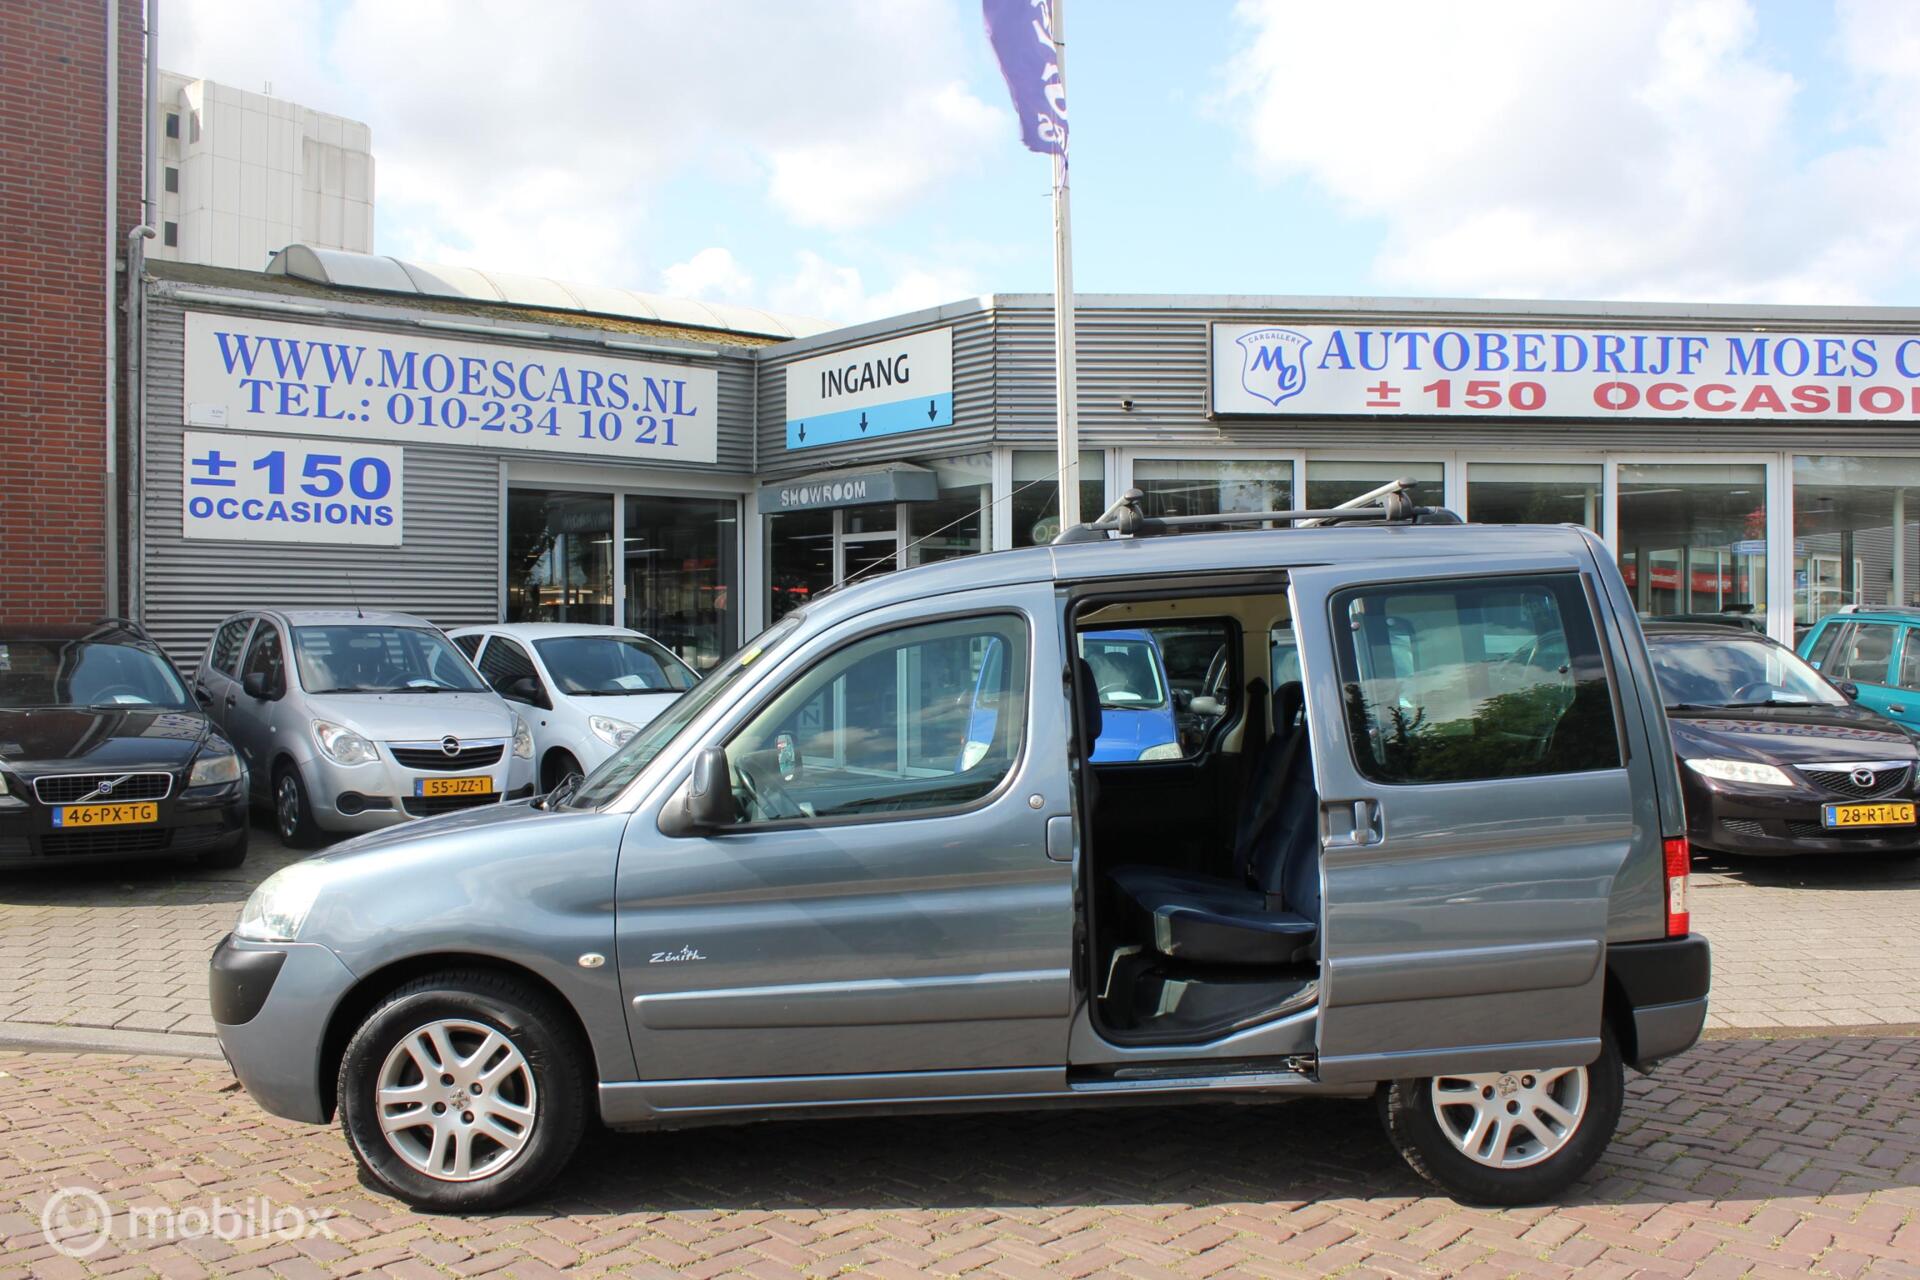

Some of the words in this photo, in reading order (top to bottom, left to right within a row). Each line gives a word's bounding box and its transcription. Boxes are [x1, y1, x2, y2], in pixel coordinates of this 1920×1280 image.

[1248, 333, 1302, 345] CARGALLERY
[1317, 329, 1709, 375] AUTOBEDRIJF
[1724, 337, 1878, 378] MOES
[213, 332, 697, 416] WWW.MOESCARS.NL
[821, 354, 909, 399] INGANG
[240, 379, 370, 422] TEL.:
[387, 393, 562, 437] 010-234
[578, 410, 622, 441] 10
[635, 416, 678, 446] 21
[1593, 382, 1920, 415] OCCASIO
[781, 480, 866, 507] SHOWROOM
[189, 497, 393, 526] OCCASIONS
[431, 780, 484, 794] 55-JZZ-1
[68, 805, 152, 823] 46-PX-TG
[1841, 806, 1910, 823] 28-RT-LG
